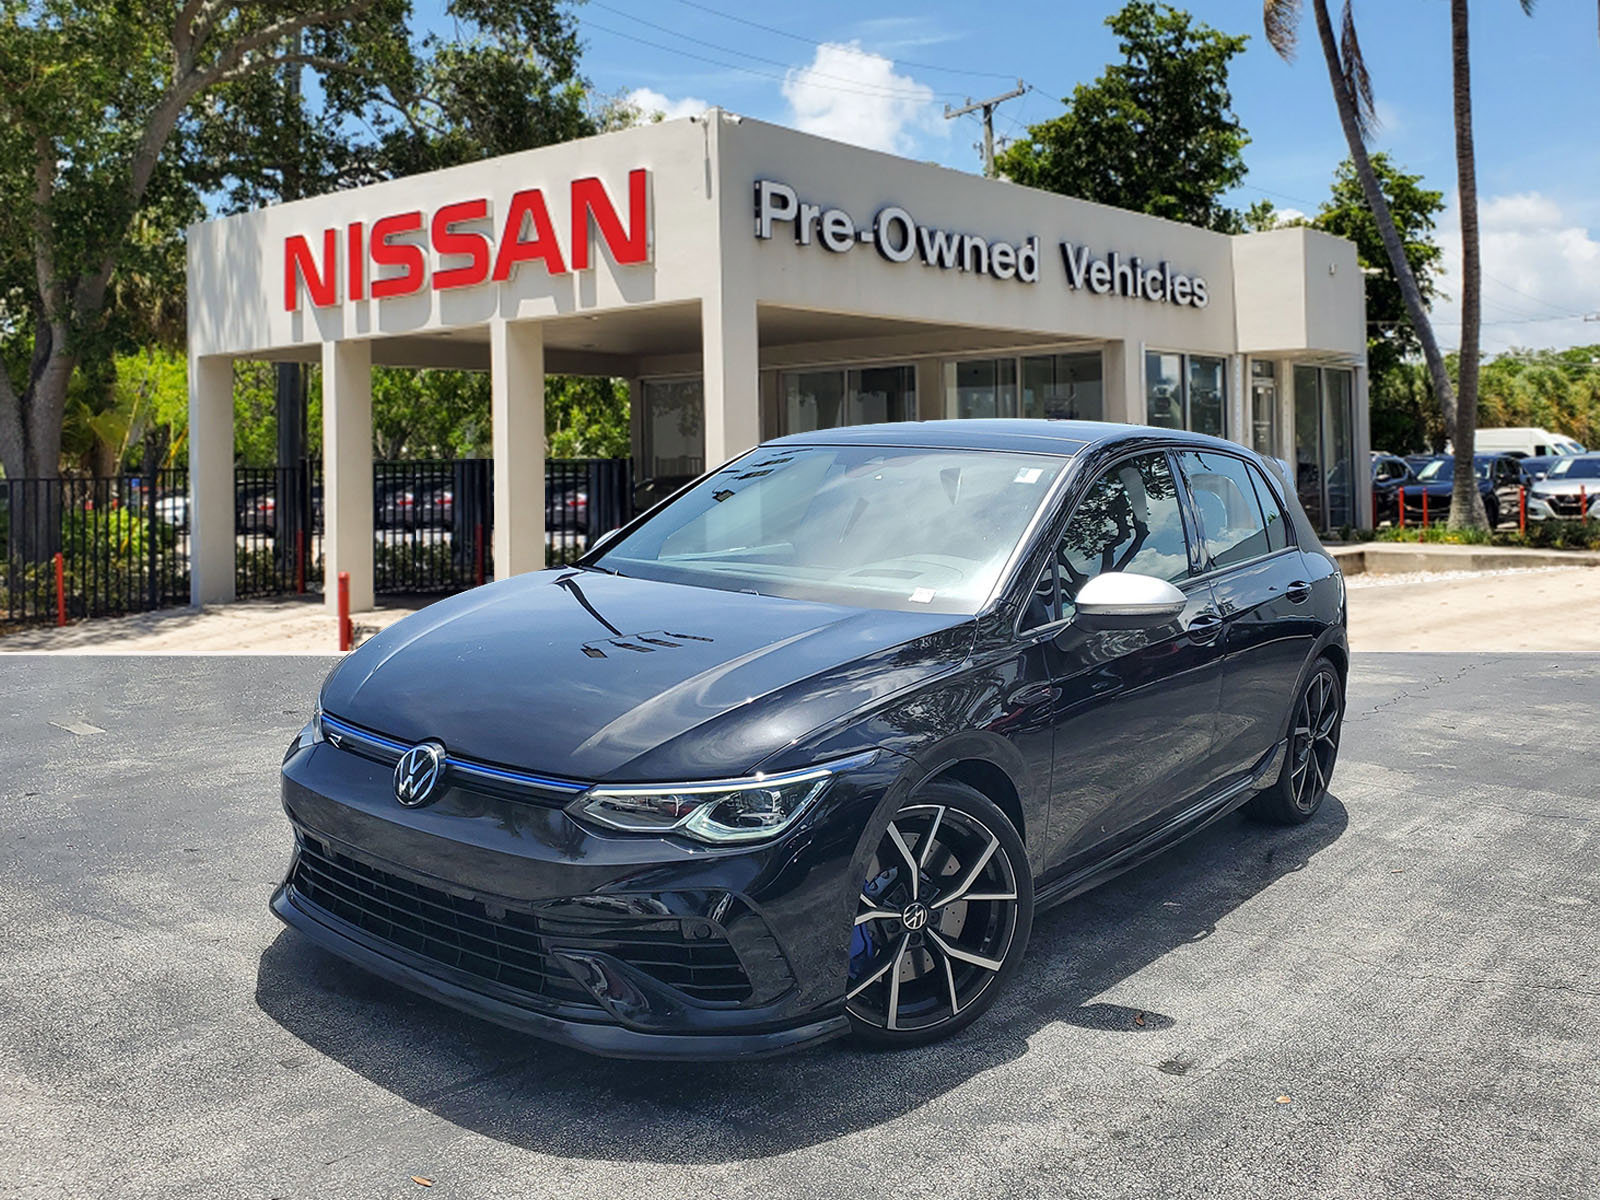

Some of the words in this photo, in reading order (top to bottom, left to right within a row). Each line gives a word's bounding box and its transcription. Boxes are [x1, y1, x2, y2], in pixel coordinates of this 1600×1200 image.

[284, 168, 650, 311] NISSAN
[754, 179, 1040, 284] Pre-Owned
[1059, 242, 1208, 308] Vehicles
